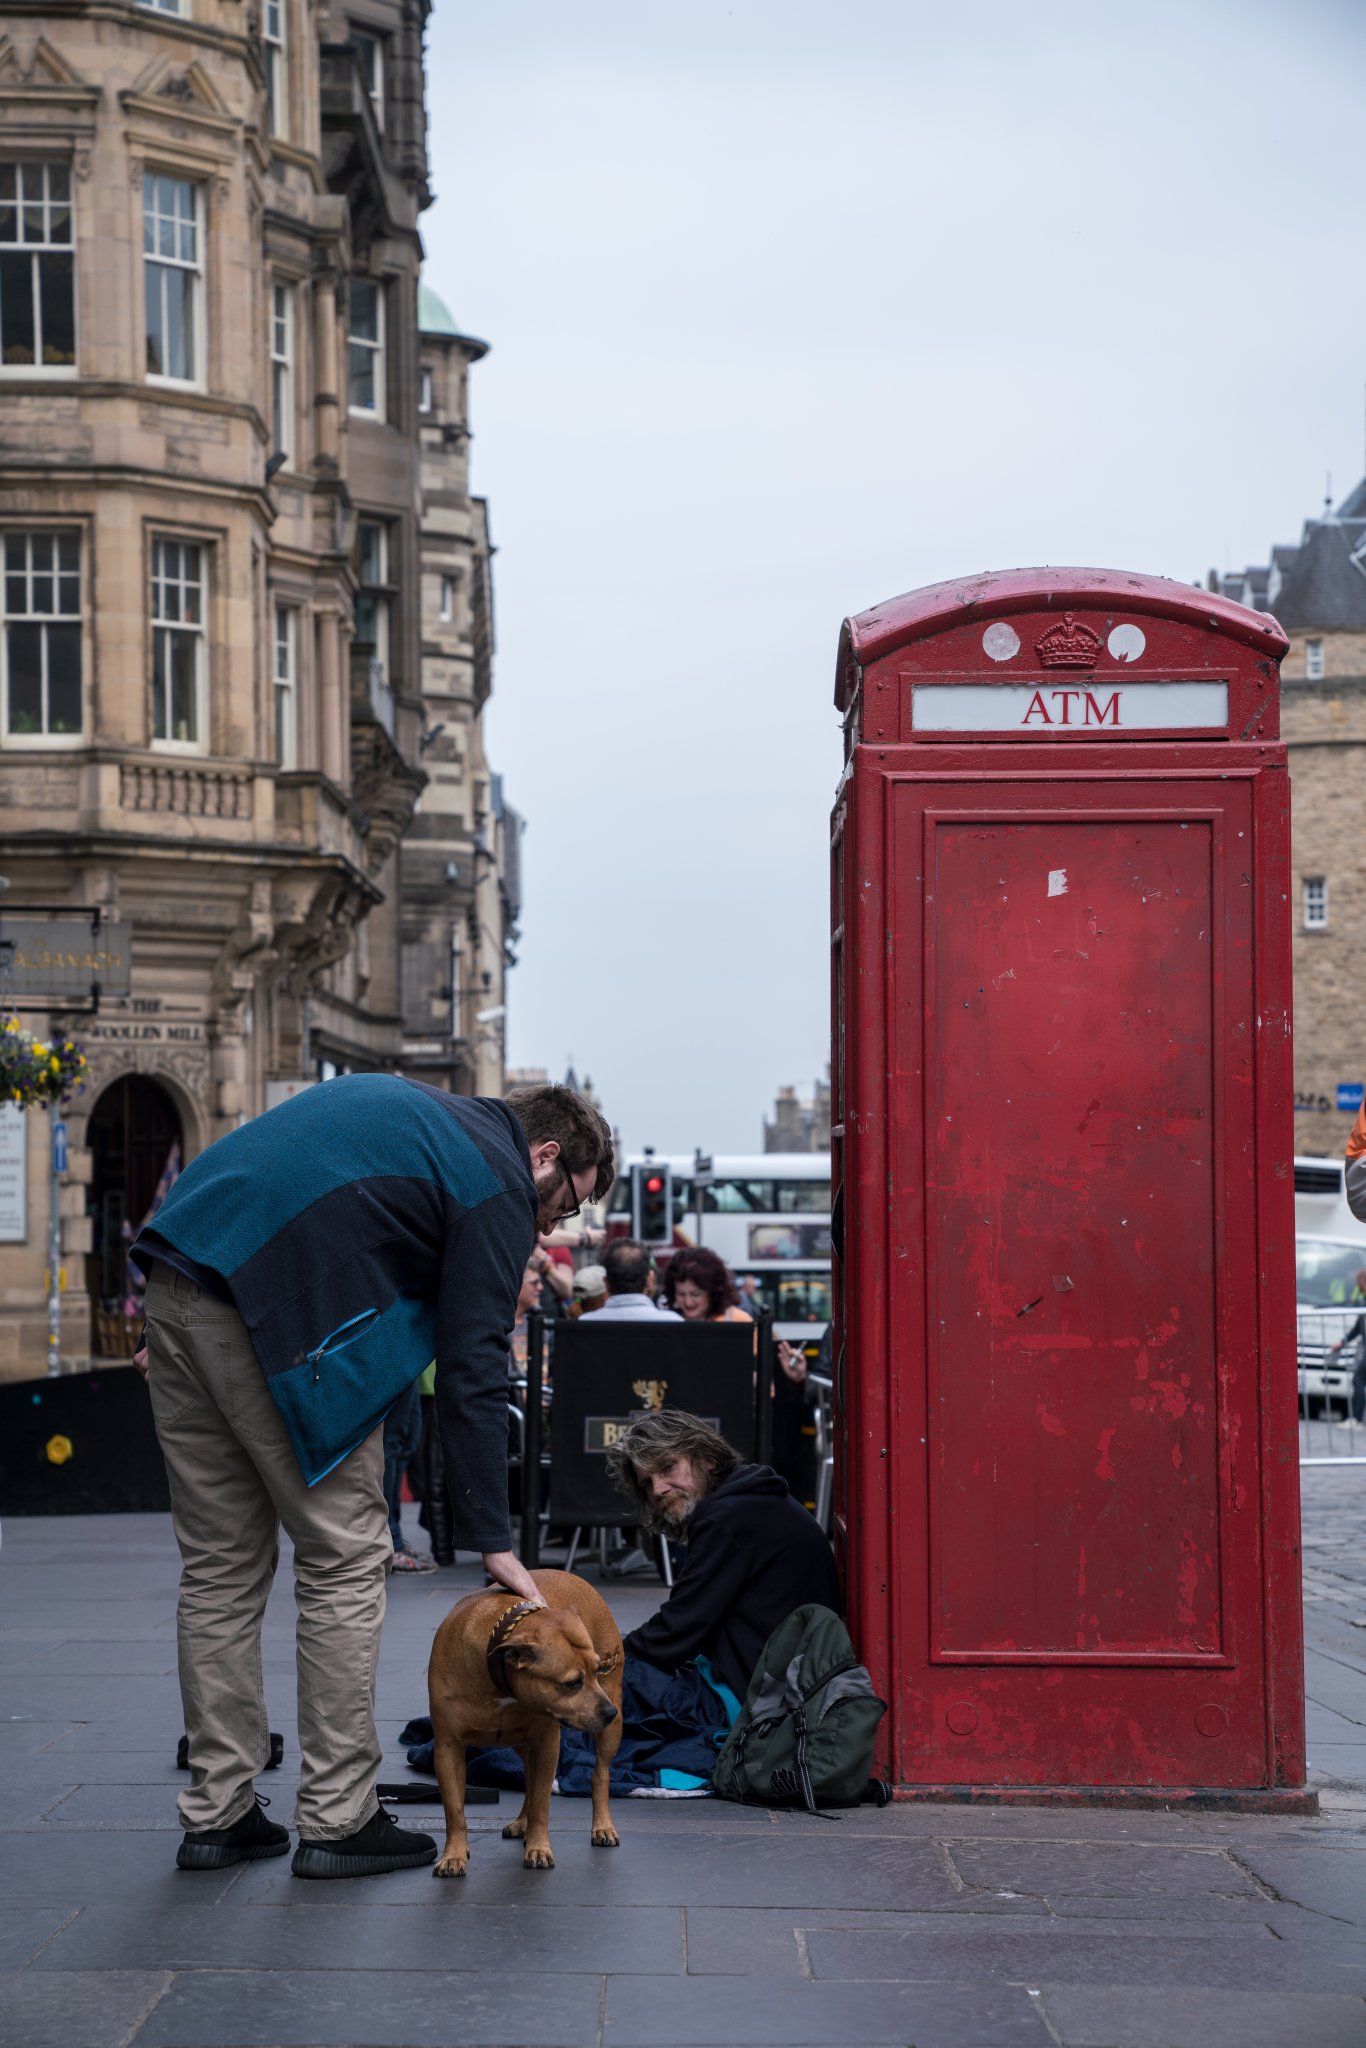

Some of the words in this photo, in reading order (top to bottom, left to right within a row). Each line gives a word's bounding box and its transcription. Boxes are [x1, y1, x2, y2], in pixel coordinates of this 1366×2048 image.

[1021, 690, 1123, 725] ATM
[13, 951, 122, 969] ALBANACH
[131, 1000, 161, 1014] THE
[167, 1027, 201, 1042] MILL
